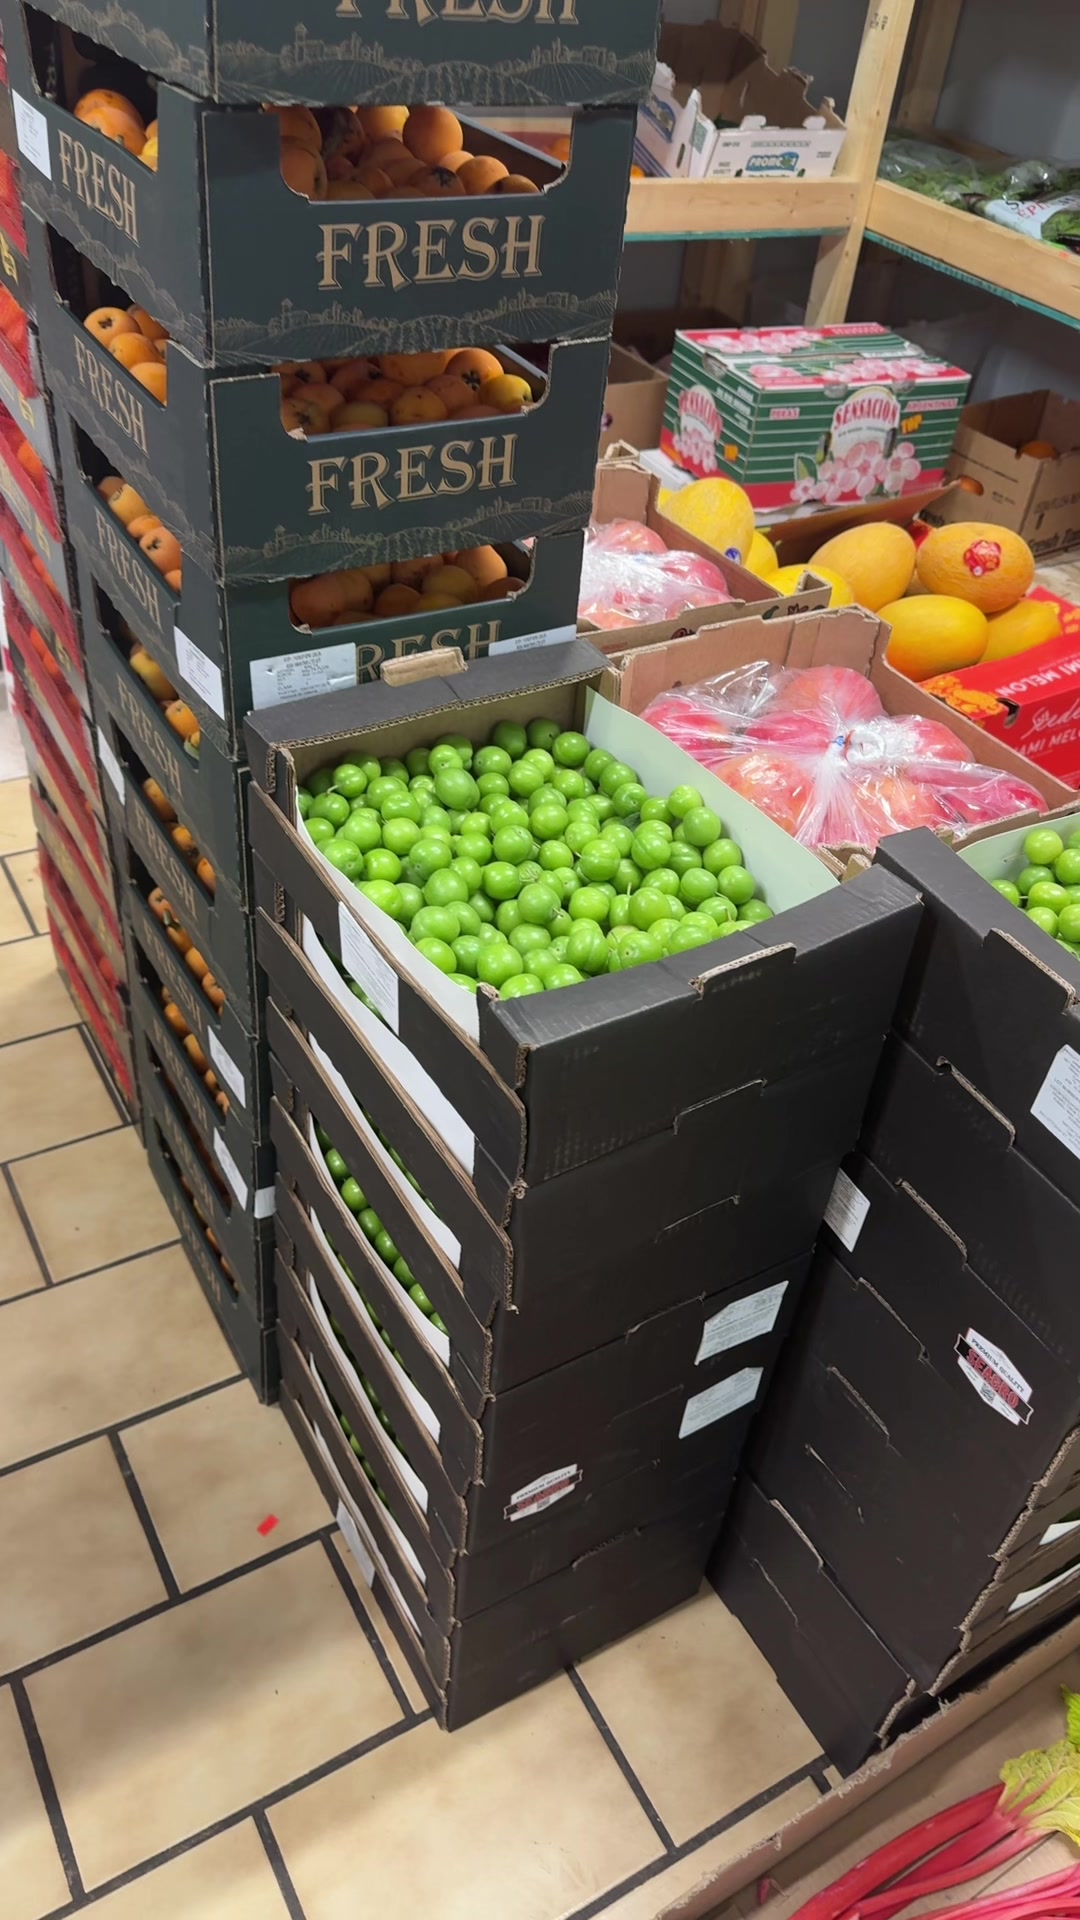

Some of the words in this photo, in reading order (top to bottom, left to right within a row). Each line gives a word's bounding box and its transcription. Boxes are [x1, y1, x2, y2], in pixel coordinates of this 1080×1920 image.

[57, 128, 139, 247] FRESH
[315, 214, 547, 292] FRESH
[73, 334, 150, 458] FRESH
[834, 398, 900, 430] SENSACION
[901, 413, 924, 436] TOP
[305, 433, 520, 516] FRESH
[94, 505, 165, 634] FRESH
[356, 619, 503, 684] RESH
[995, 669, 1061, 697] MELON
[115, 673, 183, 798] FRESH
[1013, 737, 1046, 757] AMI
[134, 798, 199, 921] FRESH
[971, 1337, 999, 1368] PREMIUM
[999, 1366, 1025, 1393] QUALITY
